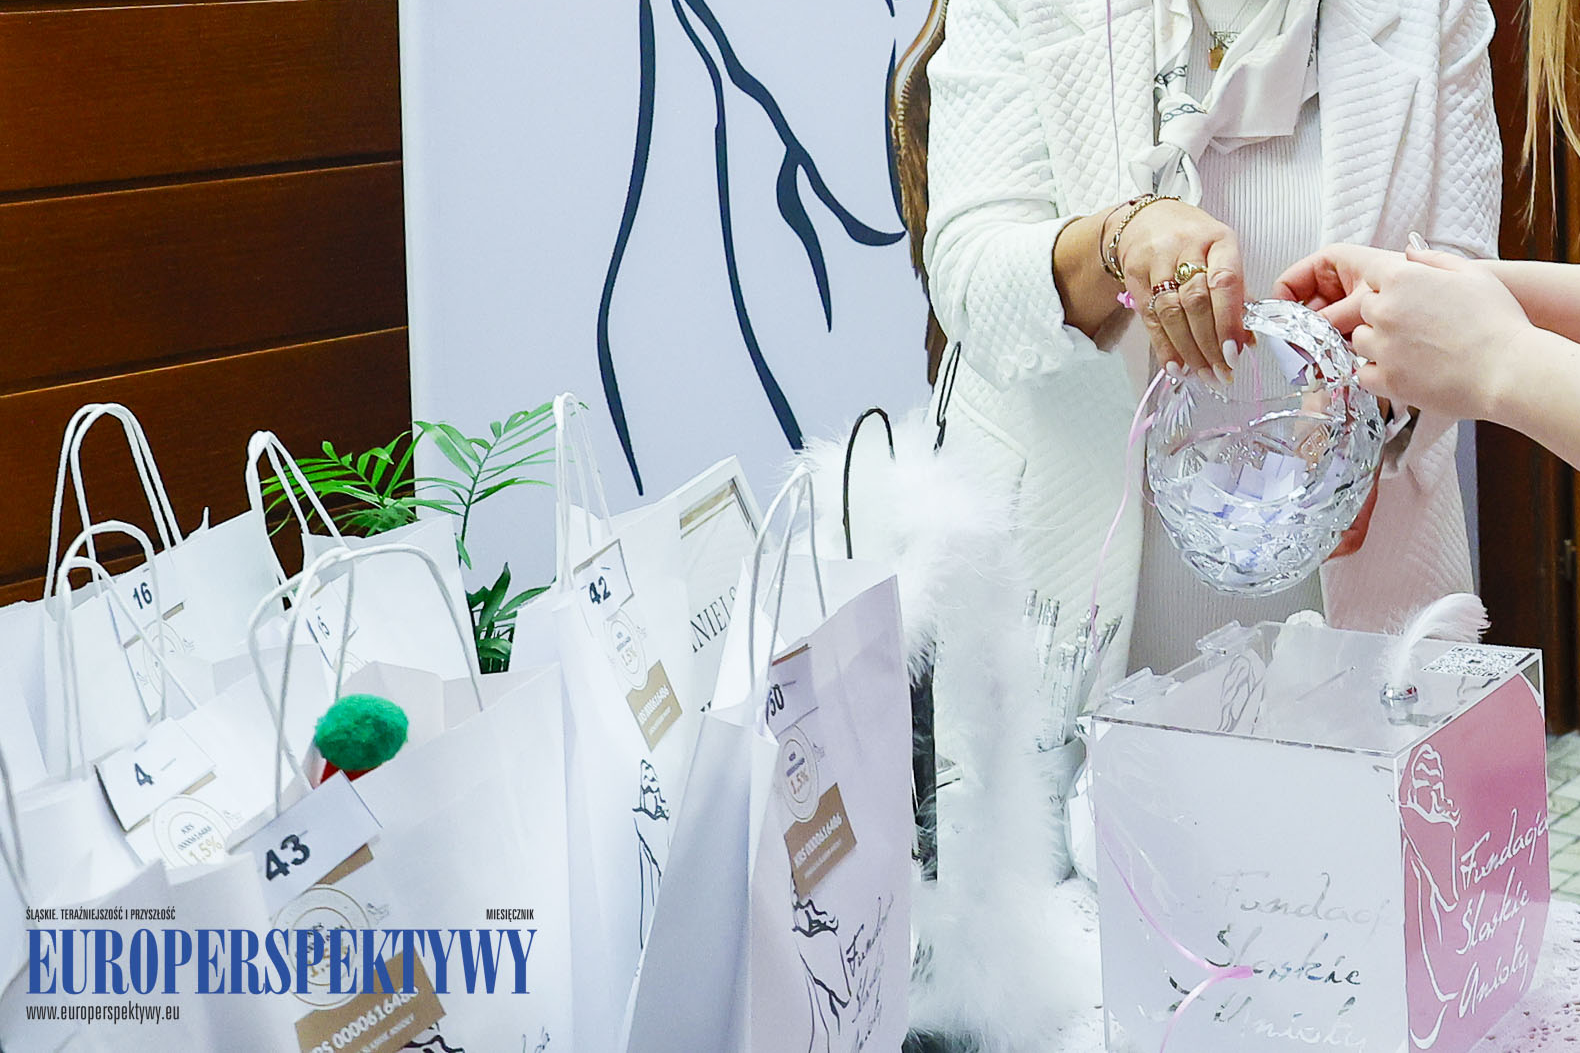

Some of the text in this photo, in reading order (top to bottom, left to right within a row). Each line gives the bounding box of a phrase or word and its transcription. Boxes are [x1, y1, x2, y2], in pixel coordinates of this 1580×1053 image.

[132, 581, 154, 610] 16
[588, 575, 612, 605] 42
[134, 762, 155, 786] 4
[265, 833, 311, 882] 43
